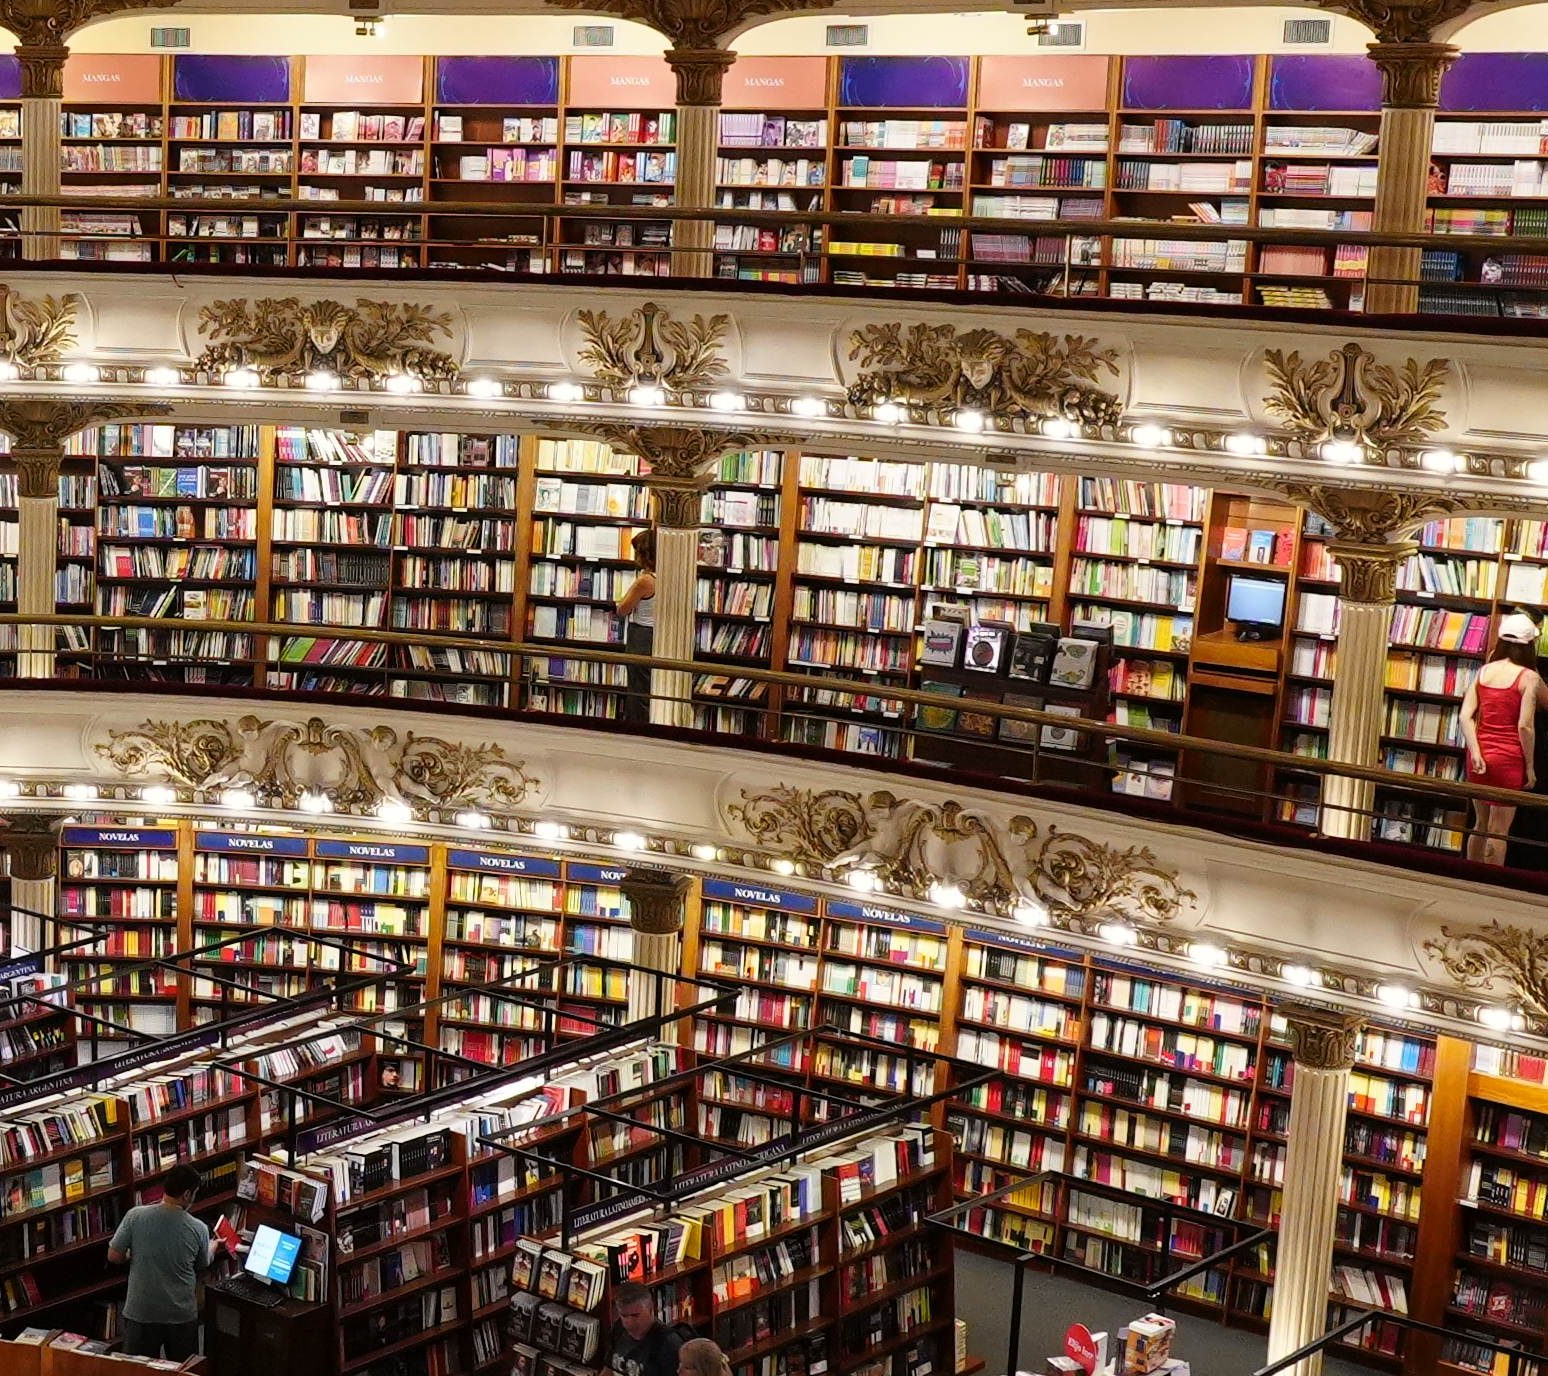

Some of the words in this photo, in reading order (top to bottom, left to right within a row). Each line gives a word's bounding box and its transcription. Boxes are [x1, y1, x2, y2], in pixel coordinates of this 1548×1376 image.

[83, 74, 121, 83] MANGAS
[345, 75, 383, 84] MANGAS
[610, 76, 650, 86] MANGAS
[745, 78, 784, 87] MANGAS
[1022, 78, 1064, 88] MANGAS
[98, 831, 140, 842] NOVELAS
[227, 838, 274, 850] NOVELAS
[348, 844, 396, 857] NOVELAS
[479, 855, 526, 870] NOVELAS
[734, 887, 781, 904] NOVELAS
[862, 906, 912, 924] NOVELAS
[0, 964, 38, 982] ARGENTINA
